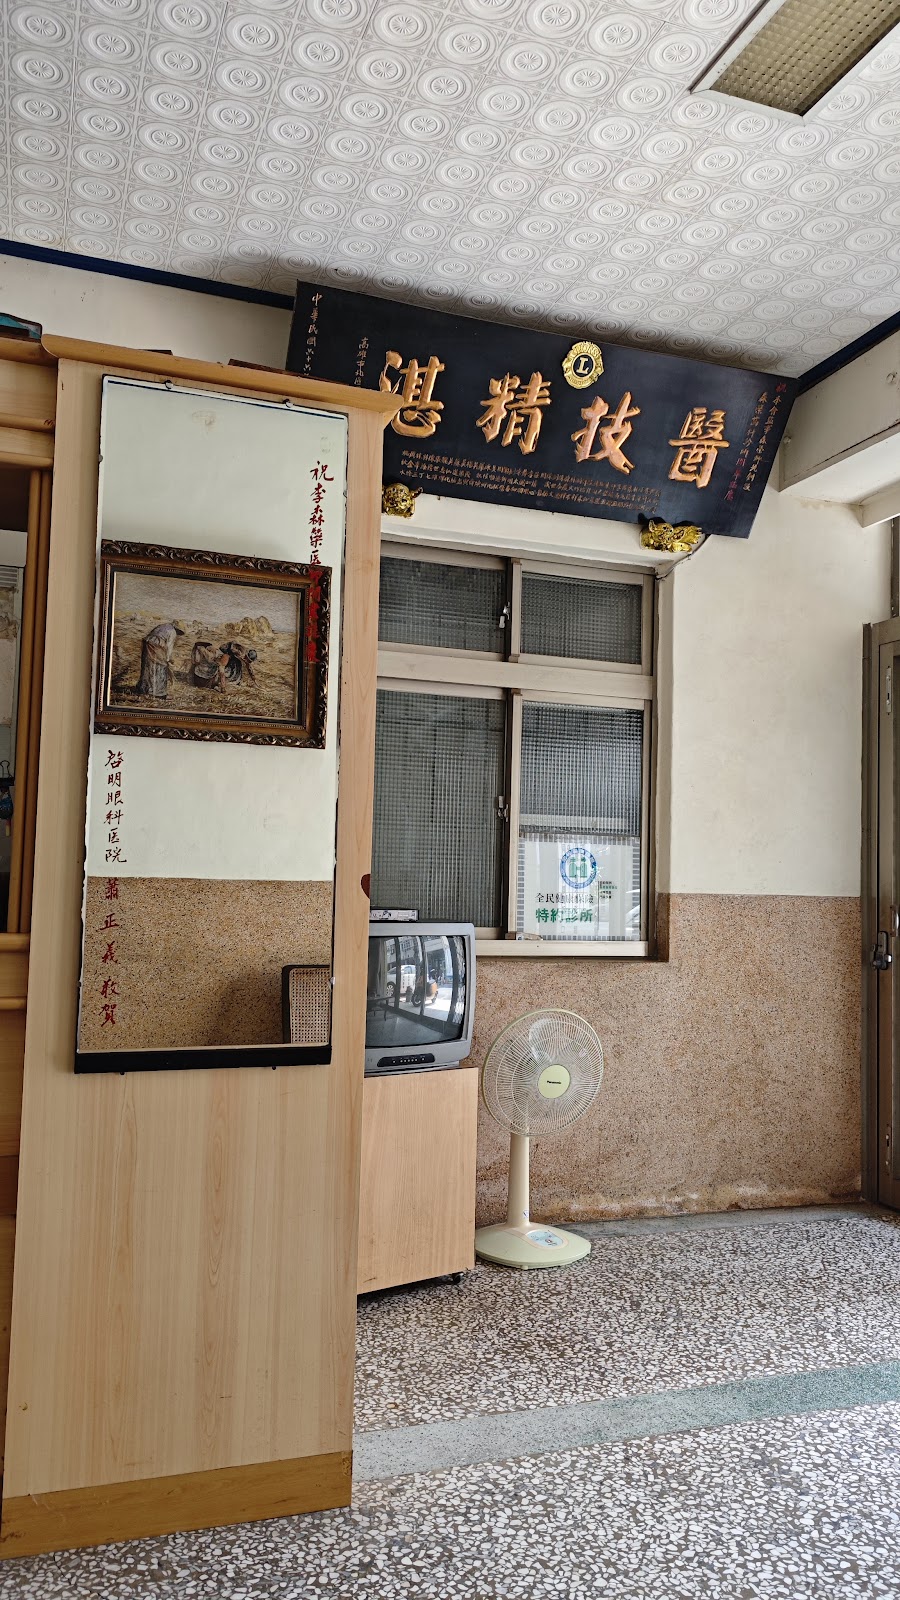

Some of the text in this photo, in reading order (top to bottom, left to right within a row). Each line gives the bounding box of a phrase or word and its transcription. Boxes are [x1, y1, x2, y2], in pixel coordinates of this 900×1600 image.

[303, 292, 323, 376] 中華民國六十六
[576, 357, 590, 374] L
